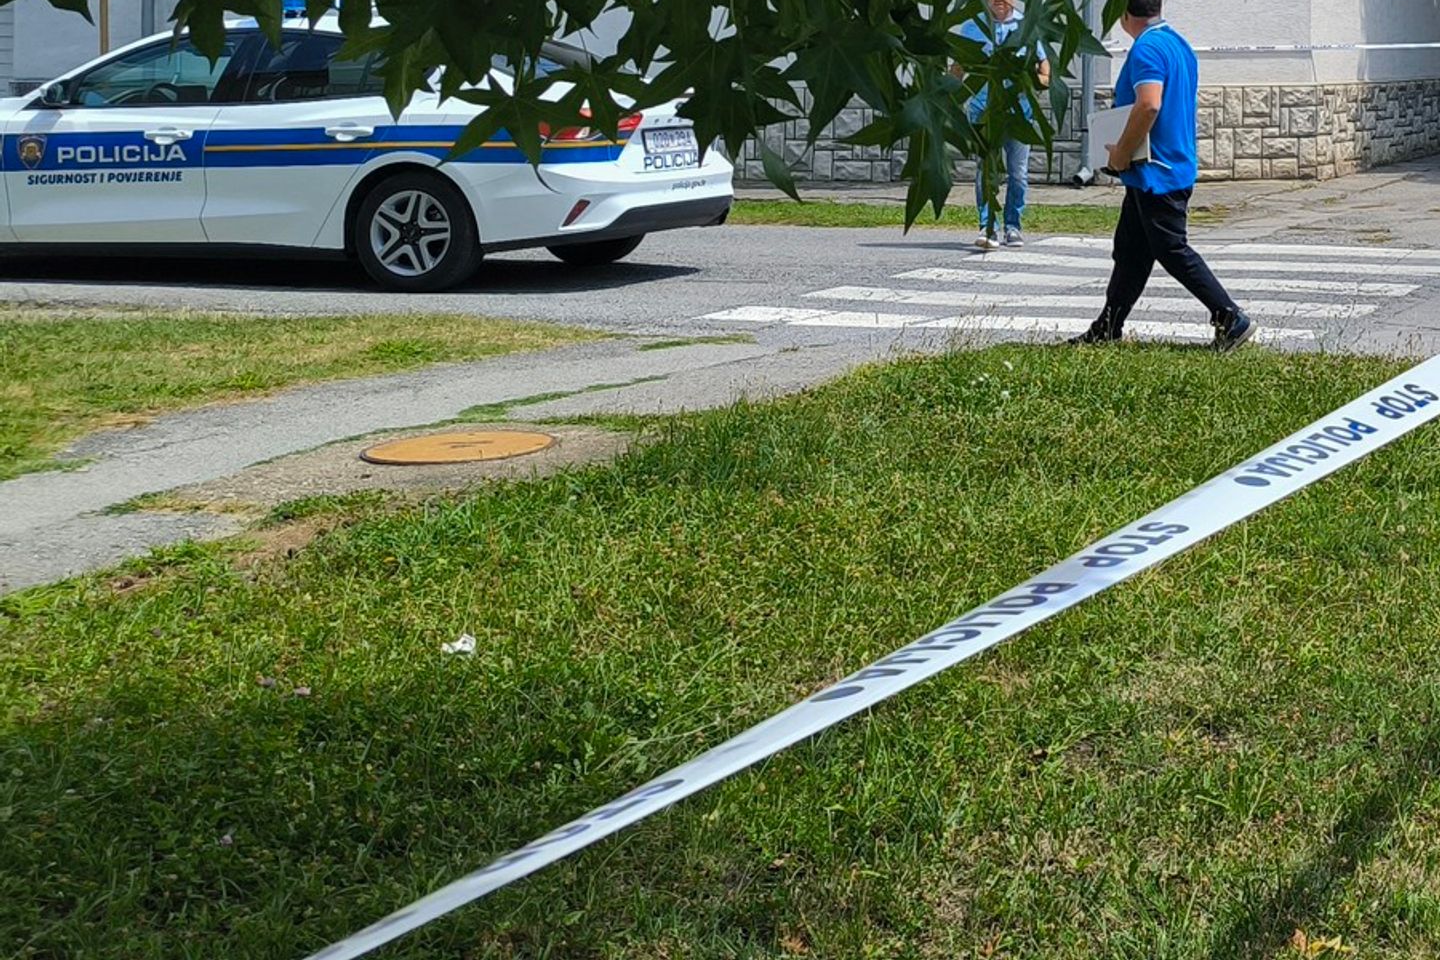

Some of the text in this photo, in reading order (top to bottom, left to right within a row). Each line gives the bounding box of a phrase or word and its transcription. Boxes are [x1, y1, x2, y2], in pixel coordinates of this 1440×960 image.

[28, 171, 183, 185] SIGURNOST I POVJERENJE
[58, 144, 187, 163] POLICIJA
[1246, 383, 1439, 478] STOP POLICIJA
[842, 522, 1189, 686] STOP POLICIJA
